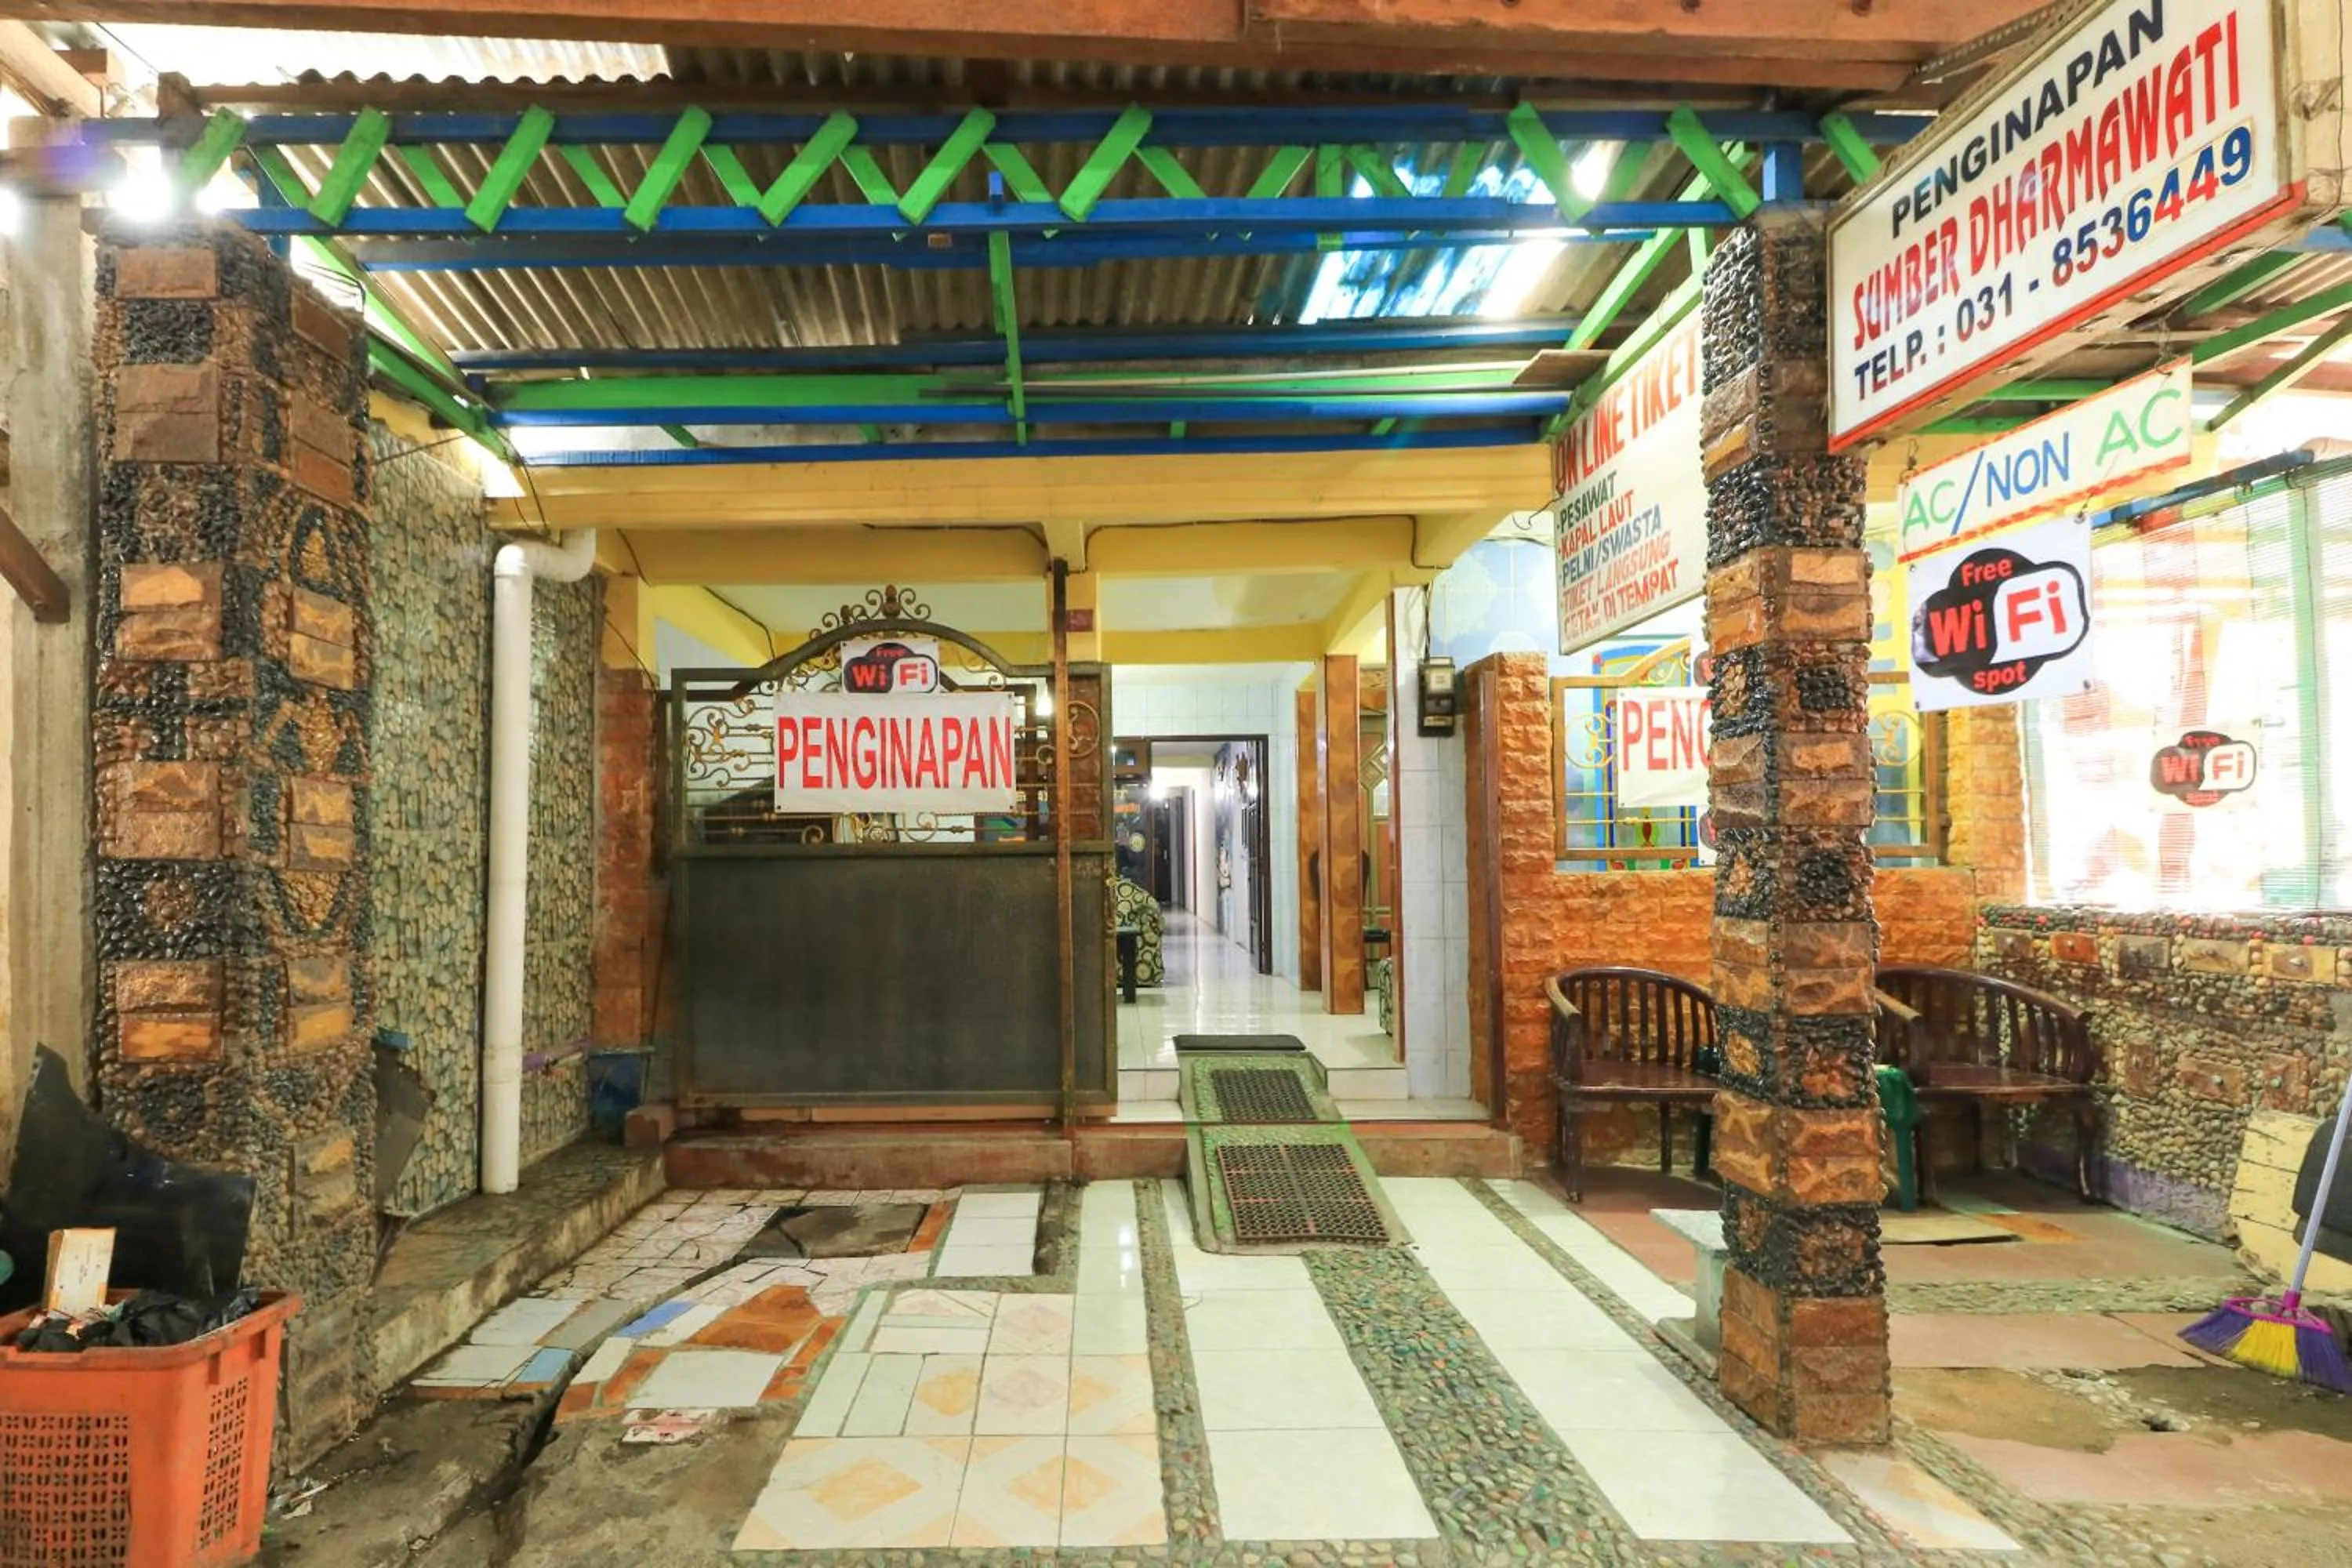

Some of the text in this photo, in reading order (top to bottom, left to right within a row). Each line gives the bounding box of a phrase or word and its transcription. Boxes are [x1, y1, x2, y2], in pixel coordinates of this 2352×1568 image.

[1892, 0, 2163, 238] PENGINAPAN
[1853, 10, 2239, 350] SUMBER DHARMAWATI
[2053, 125, 2252, 288] 8536449
[1628, 323, 1700, 440] TIKET
[2095, 388, 2184, 467] AC
[1560, 470, 1617, 533] PESAWAT
[1561, 489, 1634, 560] KAPAL LAUT
[1602, 591, 1617, 619] DI
[1617, 557, 1679, 614] TEMPAT
[1960, 557, 2015, 587] Free
[1973, 662, 2026, 693] spot
[778, 715, 1013, 790] PENGINAPAN
